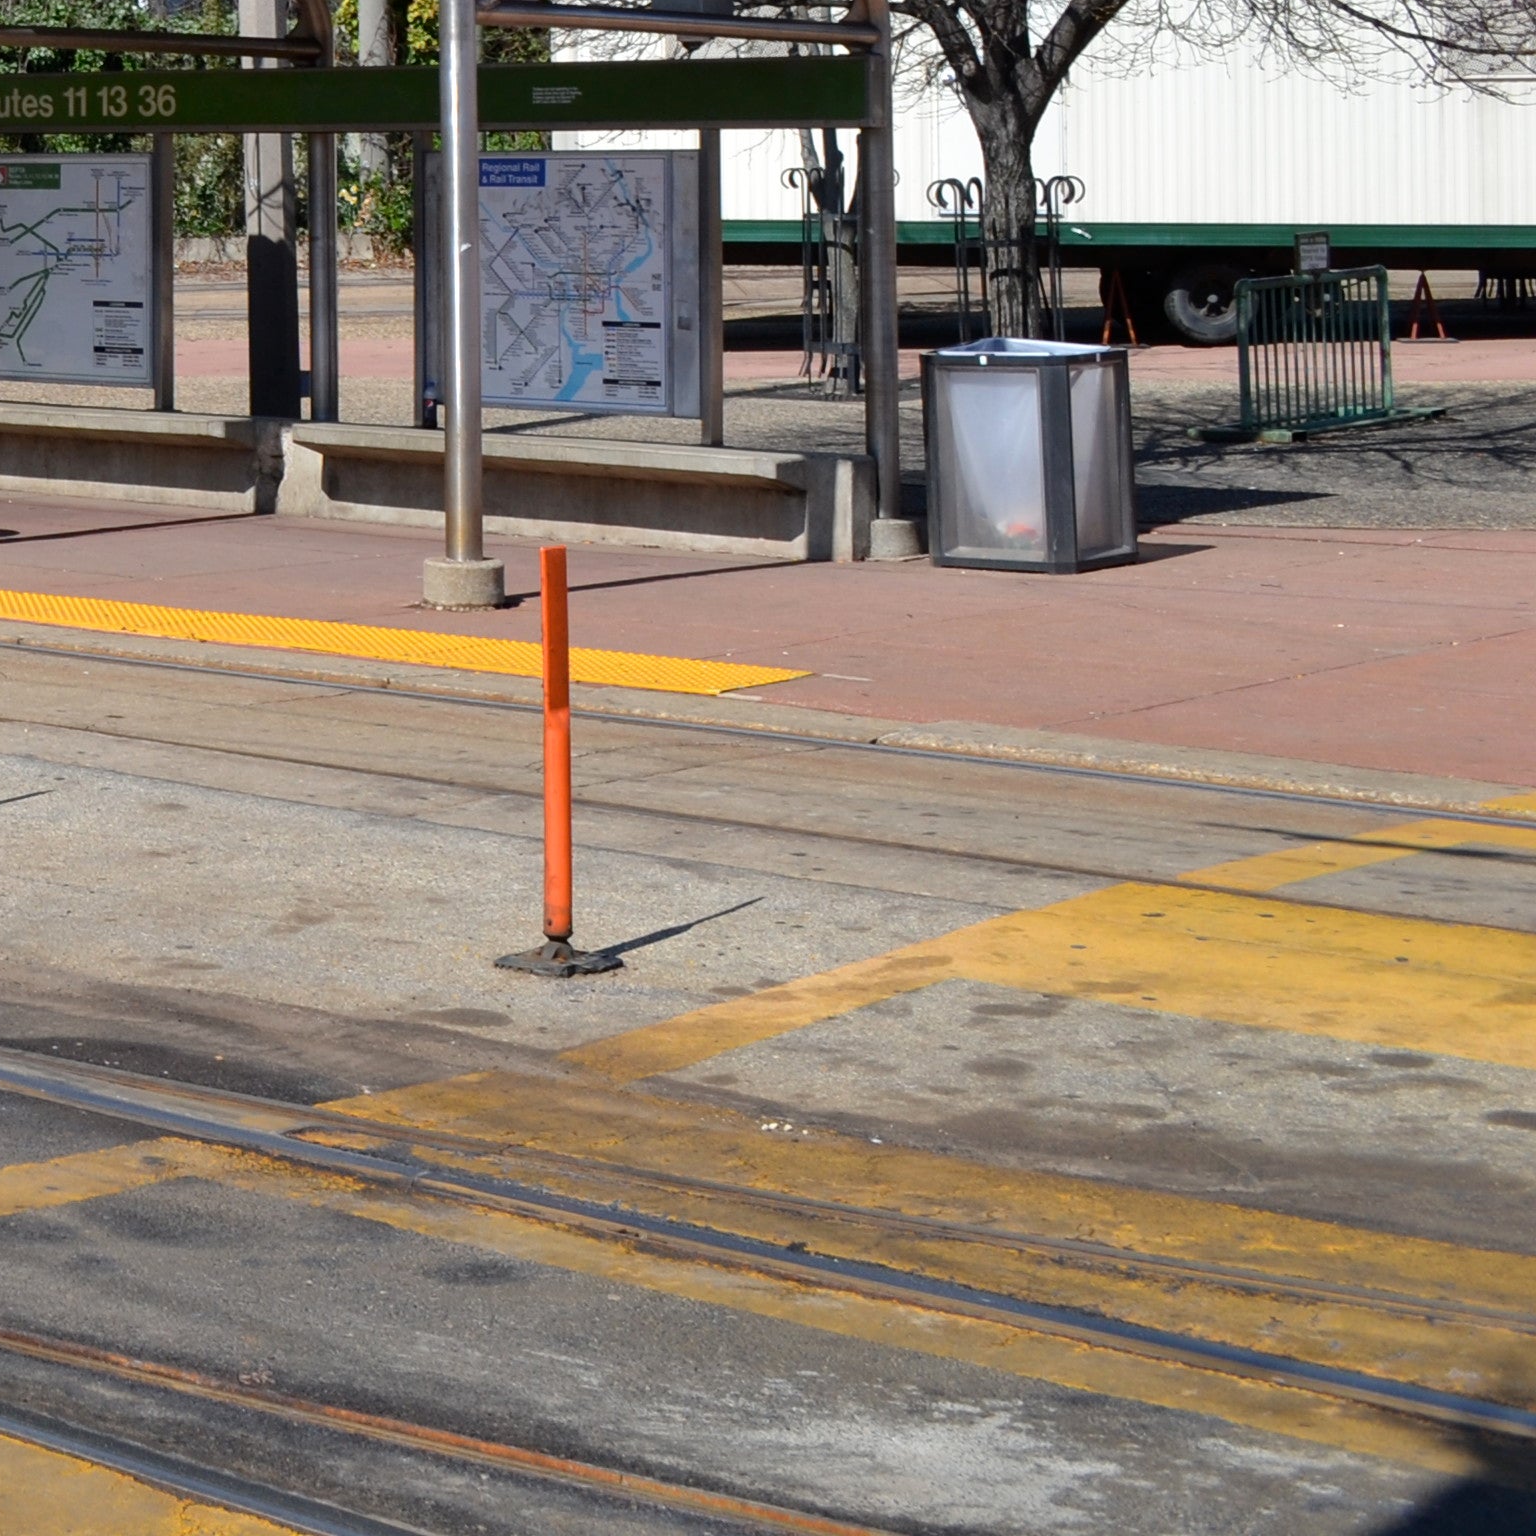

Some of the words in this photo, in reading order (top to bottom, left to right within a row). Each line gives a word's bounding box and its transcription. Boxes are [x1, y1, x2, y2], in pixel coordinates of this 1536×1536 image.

[64, 87, 87, 117] 11
[98, 85, 128, 117] 13
[139, 85, 177, 118] 36
[482, 163, 520, 174] Regional
[523, 163, 540, 172] Rail
[482, 176, 488, 184] &
[490, 175, 506, 183] Rail
[509, 175, 538, 184] Transit
